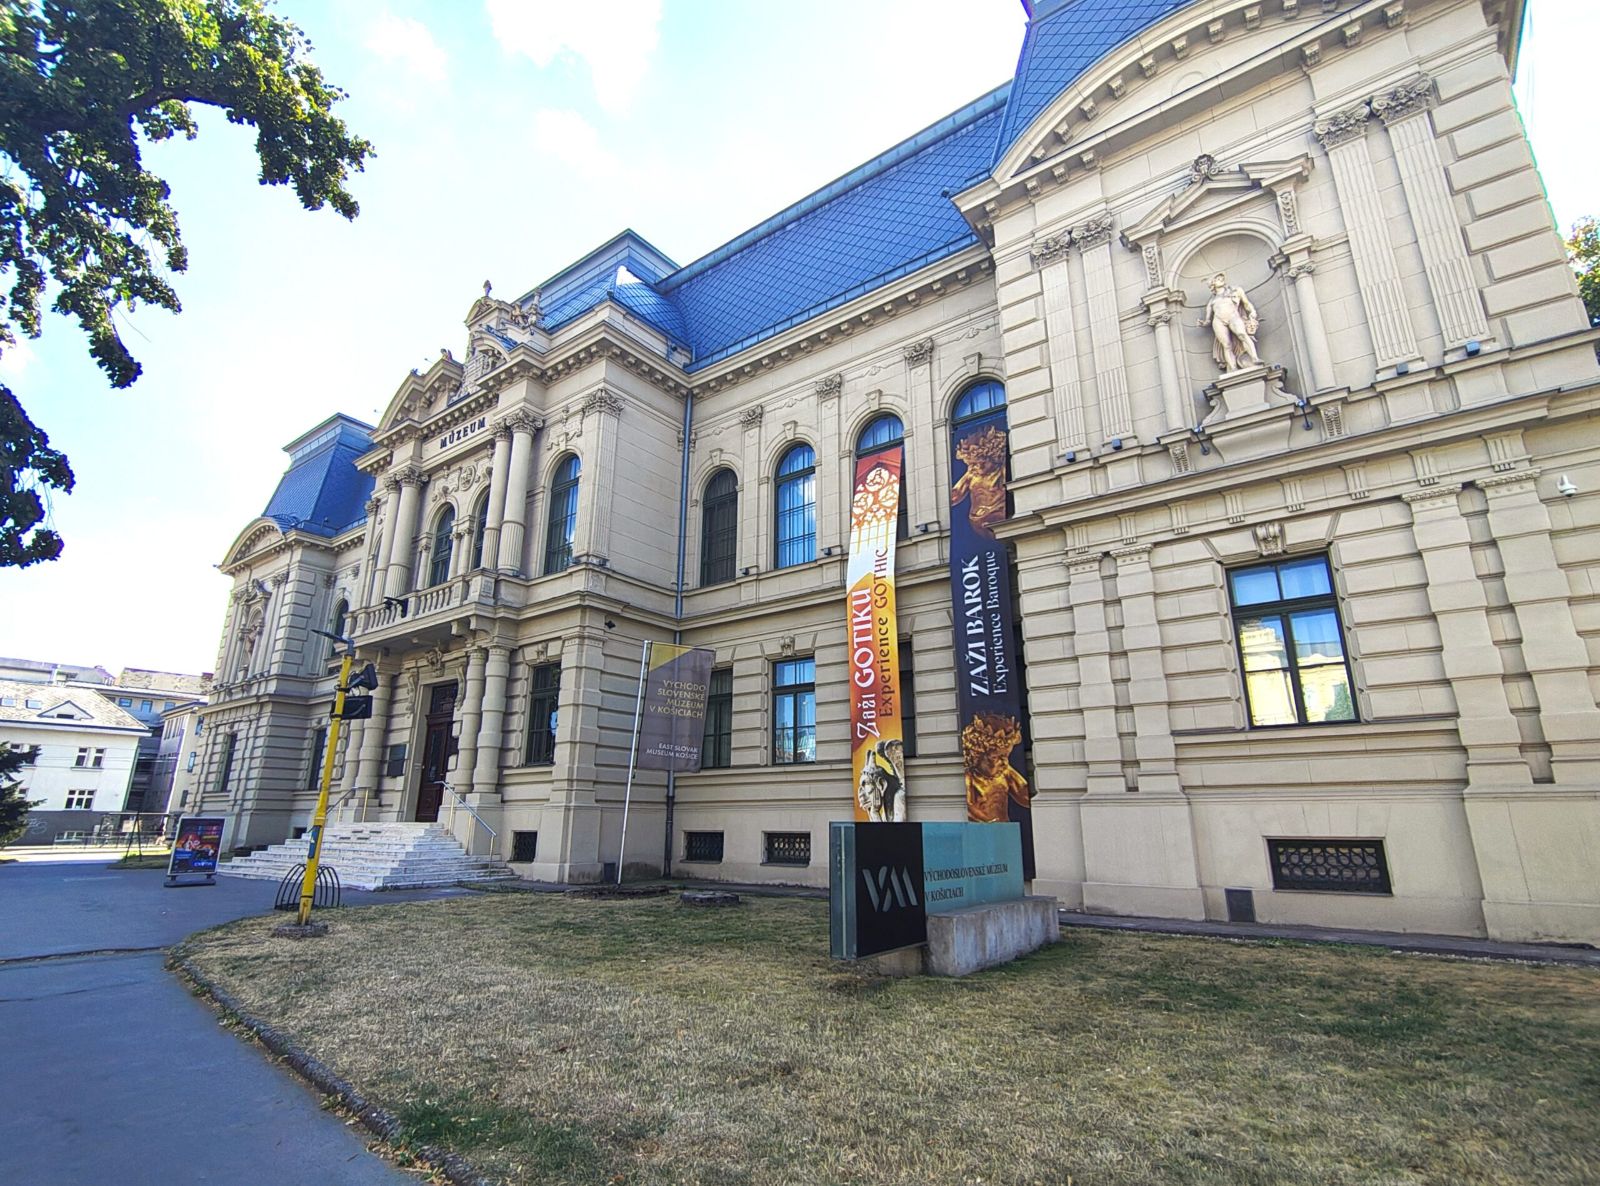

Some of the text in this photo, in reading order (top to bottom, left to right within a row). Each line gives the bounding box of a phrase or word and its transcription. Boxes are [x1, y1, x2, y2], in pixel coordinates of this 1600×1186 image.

[440, 417, 486, 449] MÚZEUM
[852, 587, 875, 688] GOTIKU
[874, 550, 895, 717] Experience GOTHIC
[961, 555, 990, 696] ZAŽI BAROK
[986, 551, 1009, 693] Experience Baroque
[657, 705, 703, 718] KOŠICIACH
[646, 748, 674, 757] MUSEUM
[674, 745, 698, 753] SLOVAK
